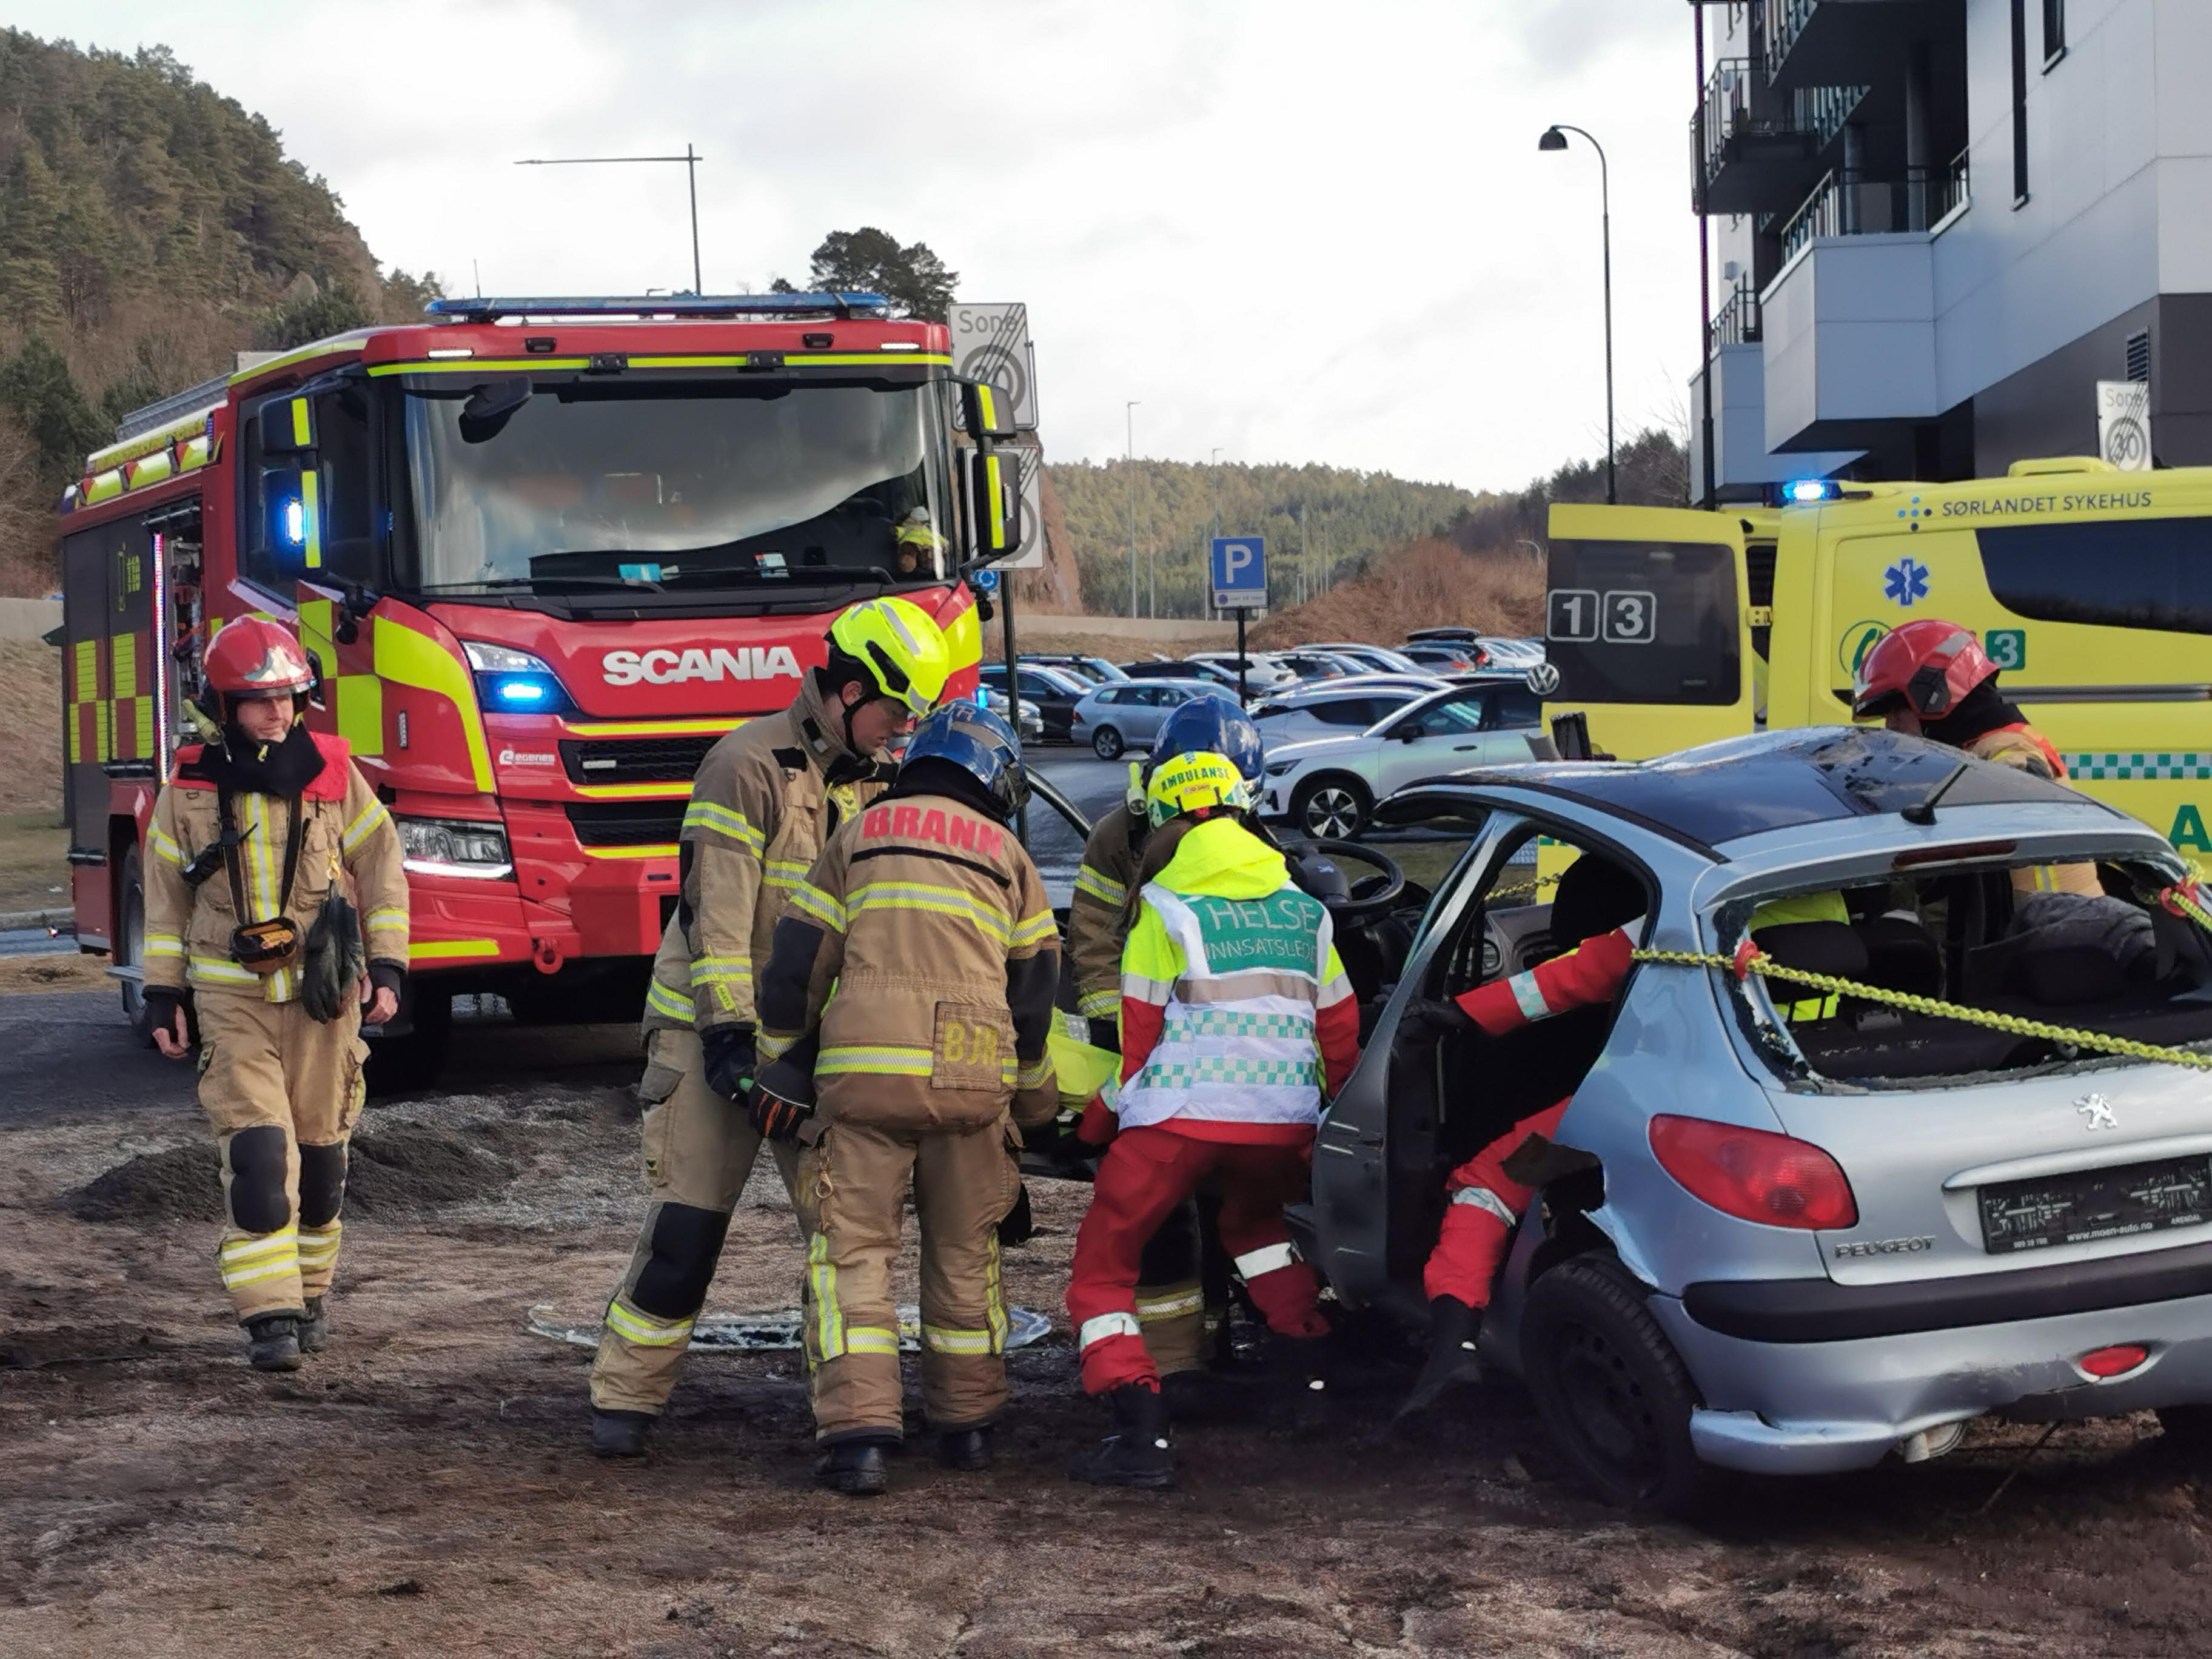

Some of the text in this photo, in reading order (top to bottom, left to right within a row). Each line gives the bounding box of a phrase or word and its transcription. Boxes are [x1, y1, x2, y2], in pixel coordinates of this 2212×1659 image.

[959, 310, 1017, 333] Sone
[2105, 388, 2142, 407] Sone
[1942, 492, 2151, 517] SØRLANDET SYKEHUS
[1225, 544, 1252, 583] P
[1563, 597, 1644, 636] 1 3
[603, 646, 803, 685] SCANIA
[1993, 633, 2018, 668] 3
[1161, 767, 1230, 793] AMBULANSE
[863, 806, 1003, 860] BRANN
[1205, 899, 1316, 934] HELSE
[943, 1021, 999, 1067] BJR
[1835, 1235, 1936, 1258] PEUGEOT
